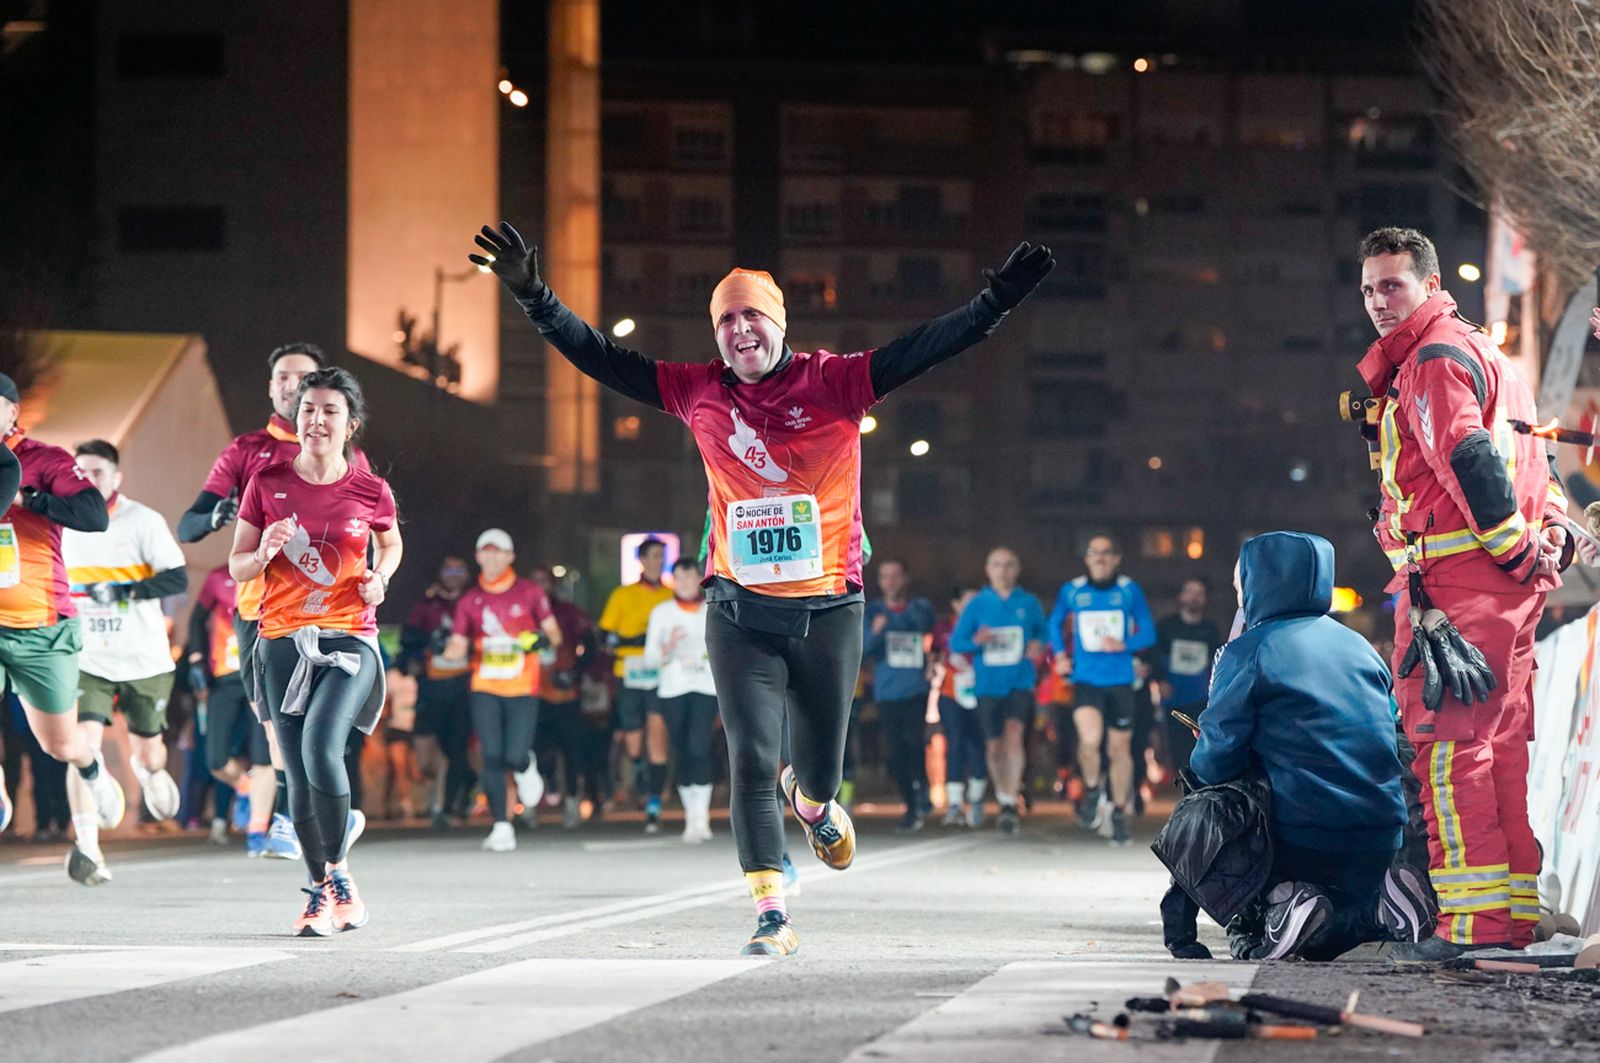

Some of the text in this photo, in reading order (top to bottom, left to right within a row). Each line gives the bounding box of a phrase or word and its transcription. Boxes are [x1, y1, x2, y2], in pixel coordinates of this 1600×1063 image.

[744, 446, 767, 469] 43
[746, 508, 772, 518] NOCHE
[774, 506, 784, 515] DE
[736, 520, 753, 530] SAN
[755, 514, 785, 528] ANTÓN
[747, 526, 802, 556] 1976
[299, 552, 320, 574] 43
[89, 617, 122, 632] 3912
